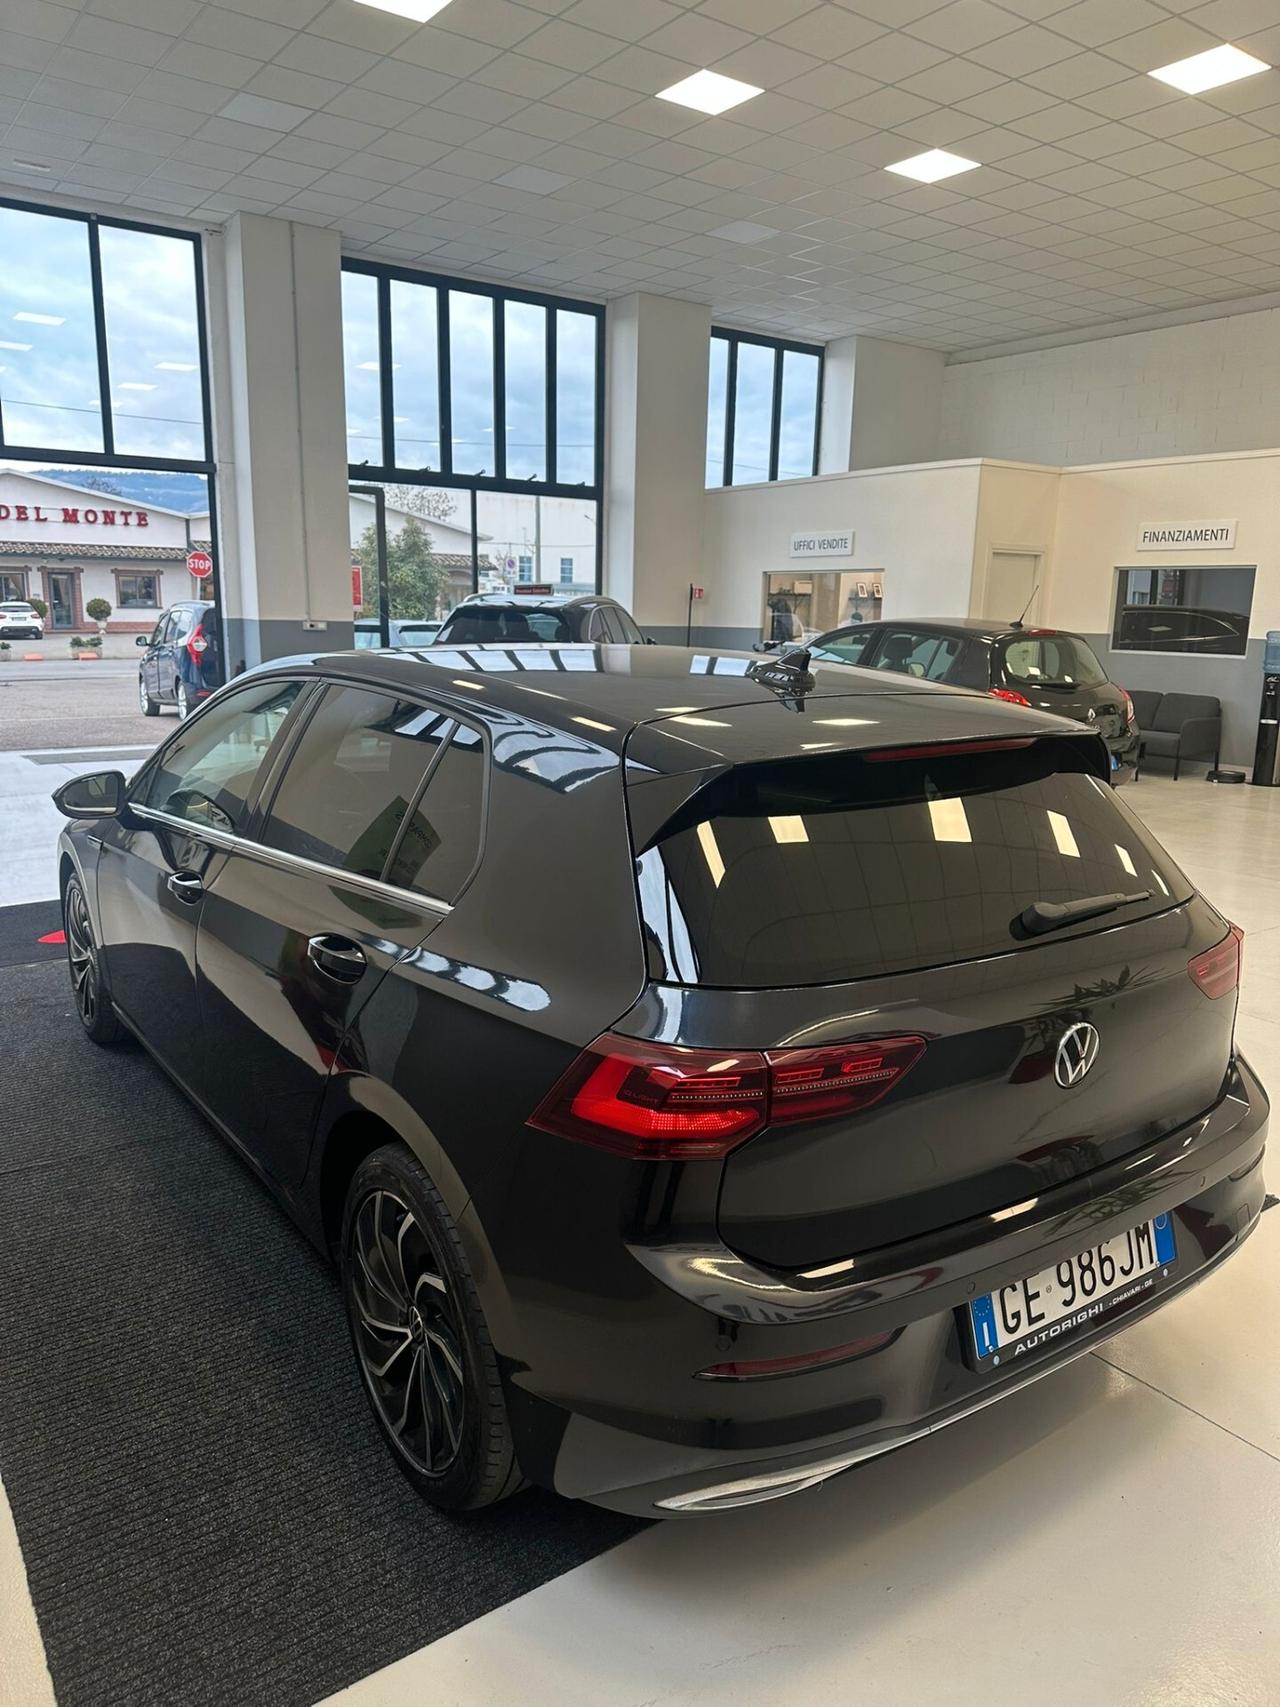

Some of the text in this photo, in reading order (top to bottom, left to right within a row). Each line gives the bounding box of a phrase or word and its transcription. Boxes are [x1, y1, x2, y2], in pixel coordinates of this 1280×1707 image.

[0, 505, 149, 526] DEL MONTE
[793, 538, 848, 551] UFFICI VENDITE
[1142, 528, 1229, 543] FINANZIAMENTI
[188, 558, 211, 569] STOP
[1000, 1276, 1045, 1335] GE
[1014, 1303, 1104, 1355] AUTORIGHI
[1112, 1285, 1141, 1305] CHIAVARI
